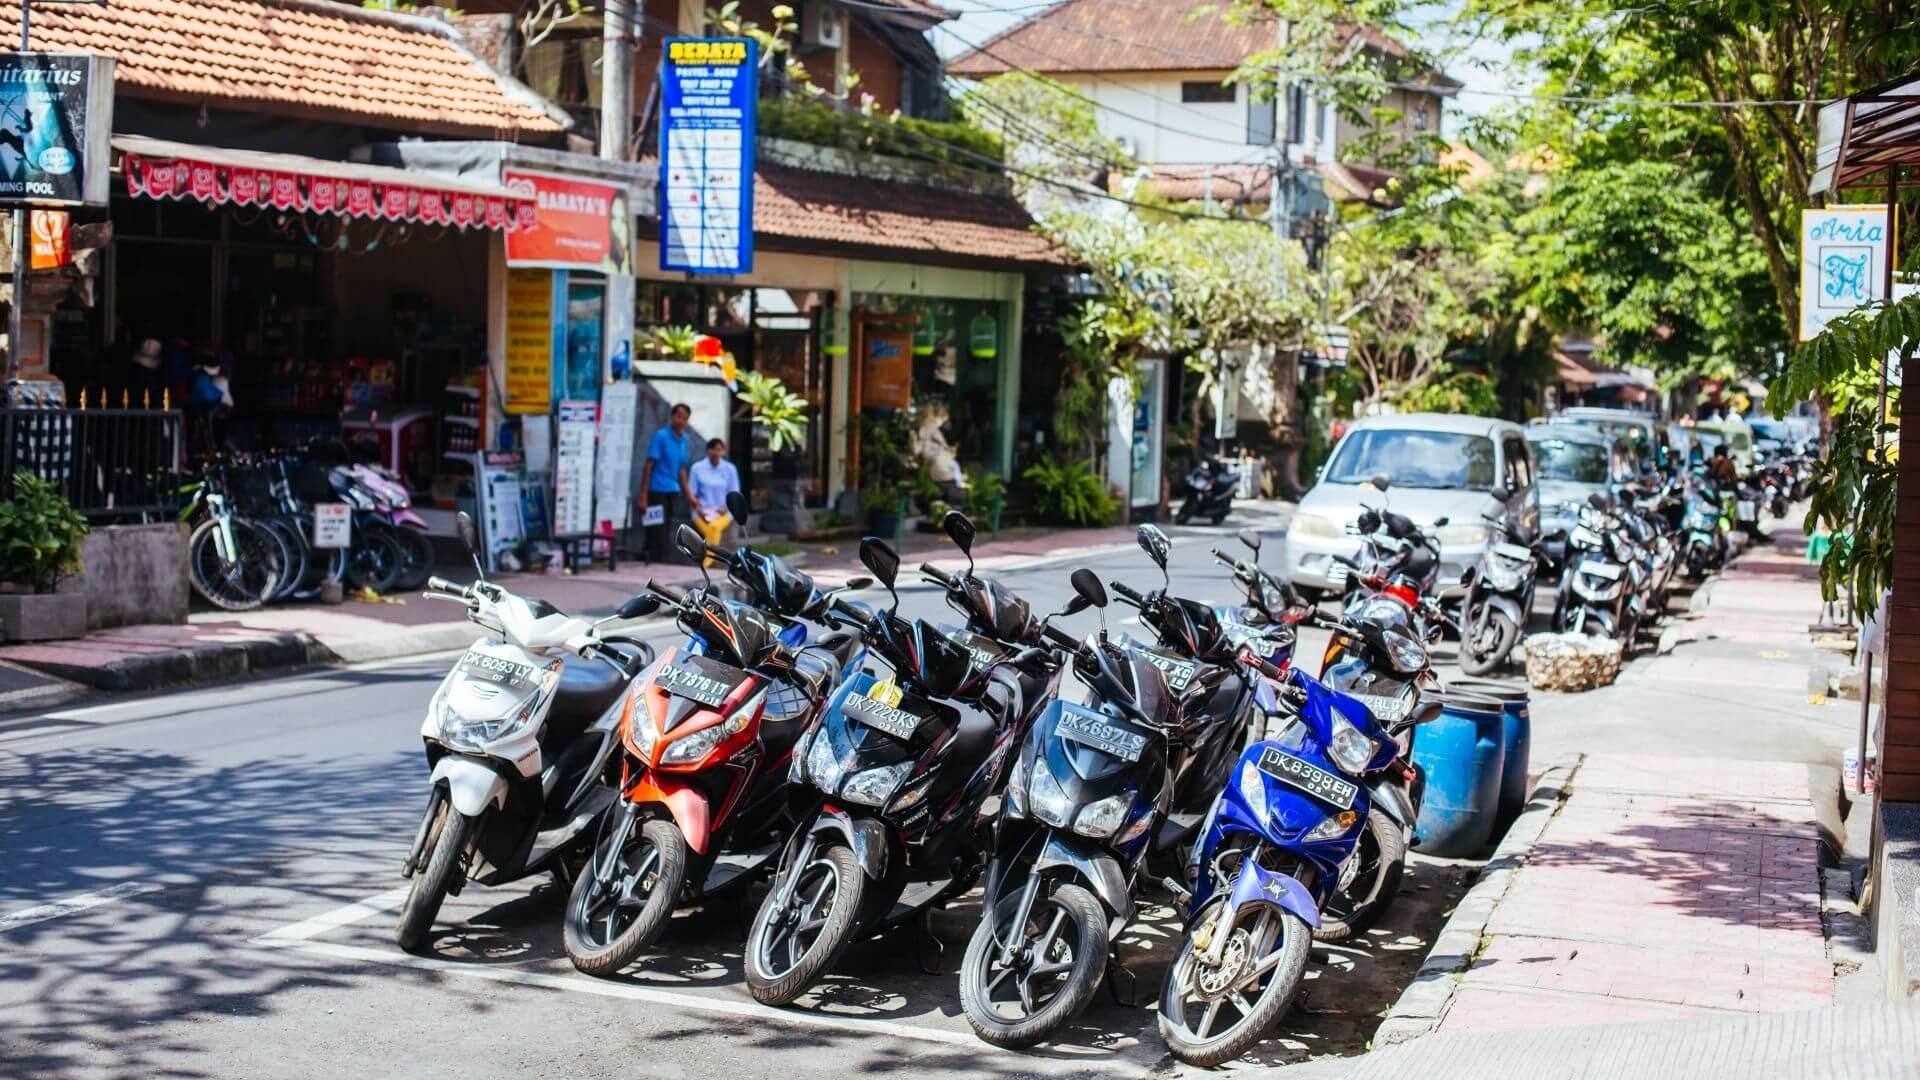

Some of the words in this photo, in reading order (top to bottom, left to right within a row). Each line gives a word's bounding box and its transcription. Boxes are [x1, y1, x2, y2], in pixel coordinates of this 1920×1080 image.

[25, 182, 56, 195] POOL
[1810, 218, 1883, 242] Aria
[464, 652, 482, 666] DK
[481, 656, 515, 673] 6093
[515, 665, 531, 677] LY
[660, 665, 682, 681] DK
[711, 681, 730, 696] IT
